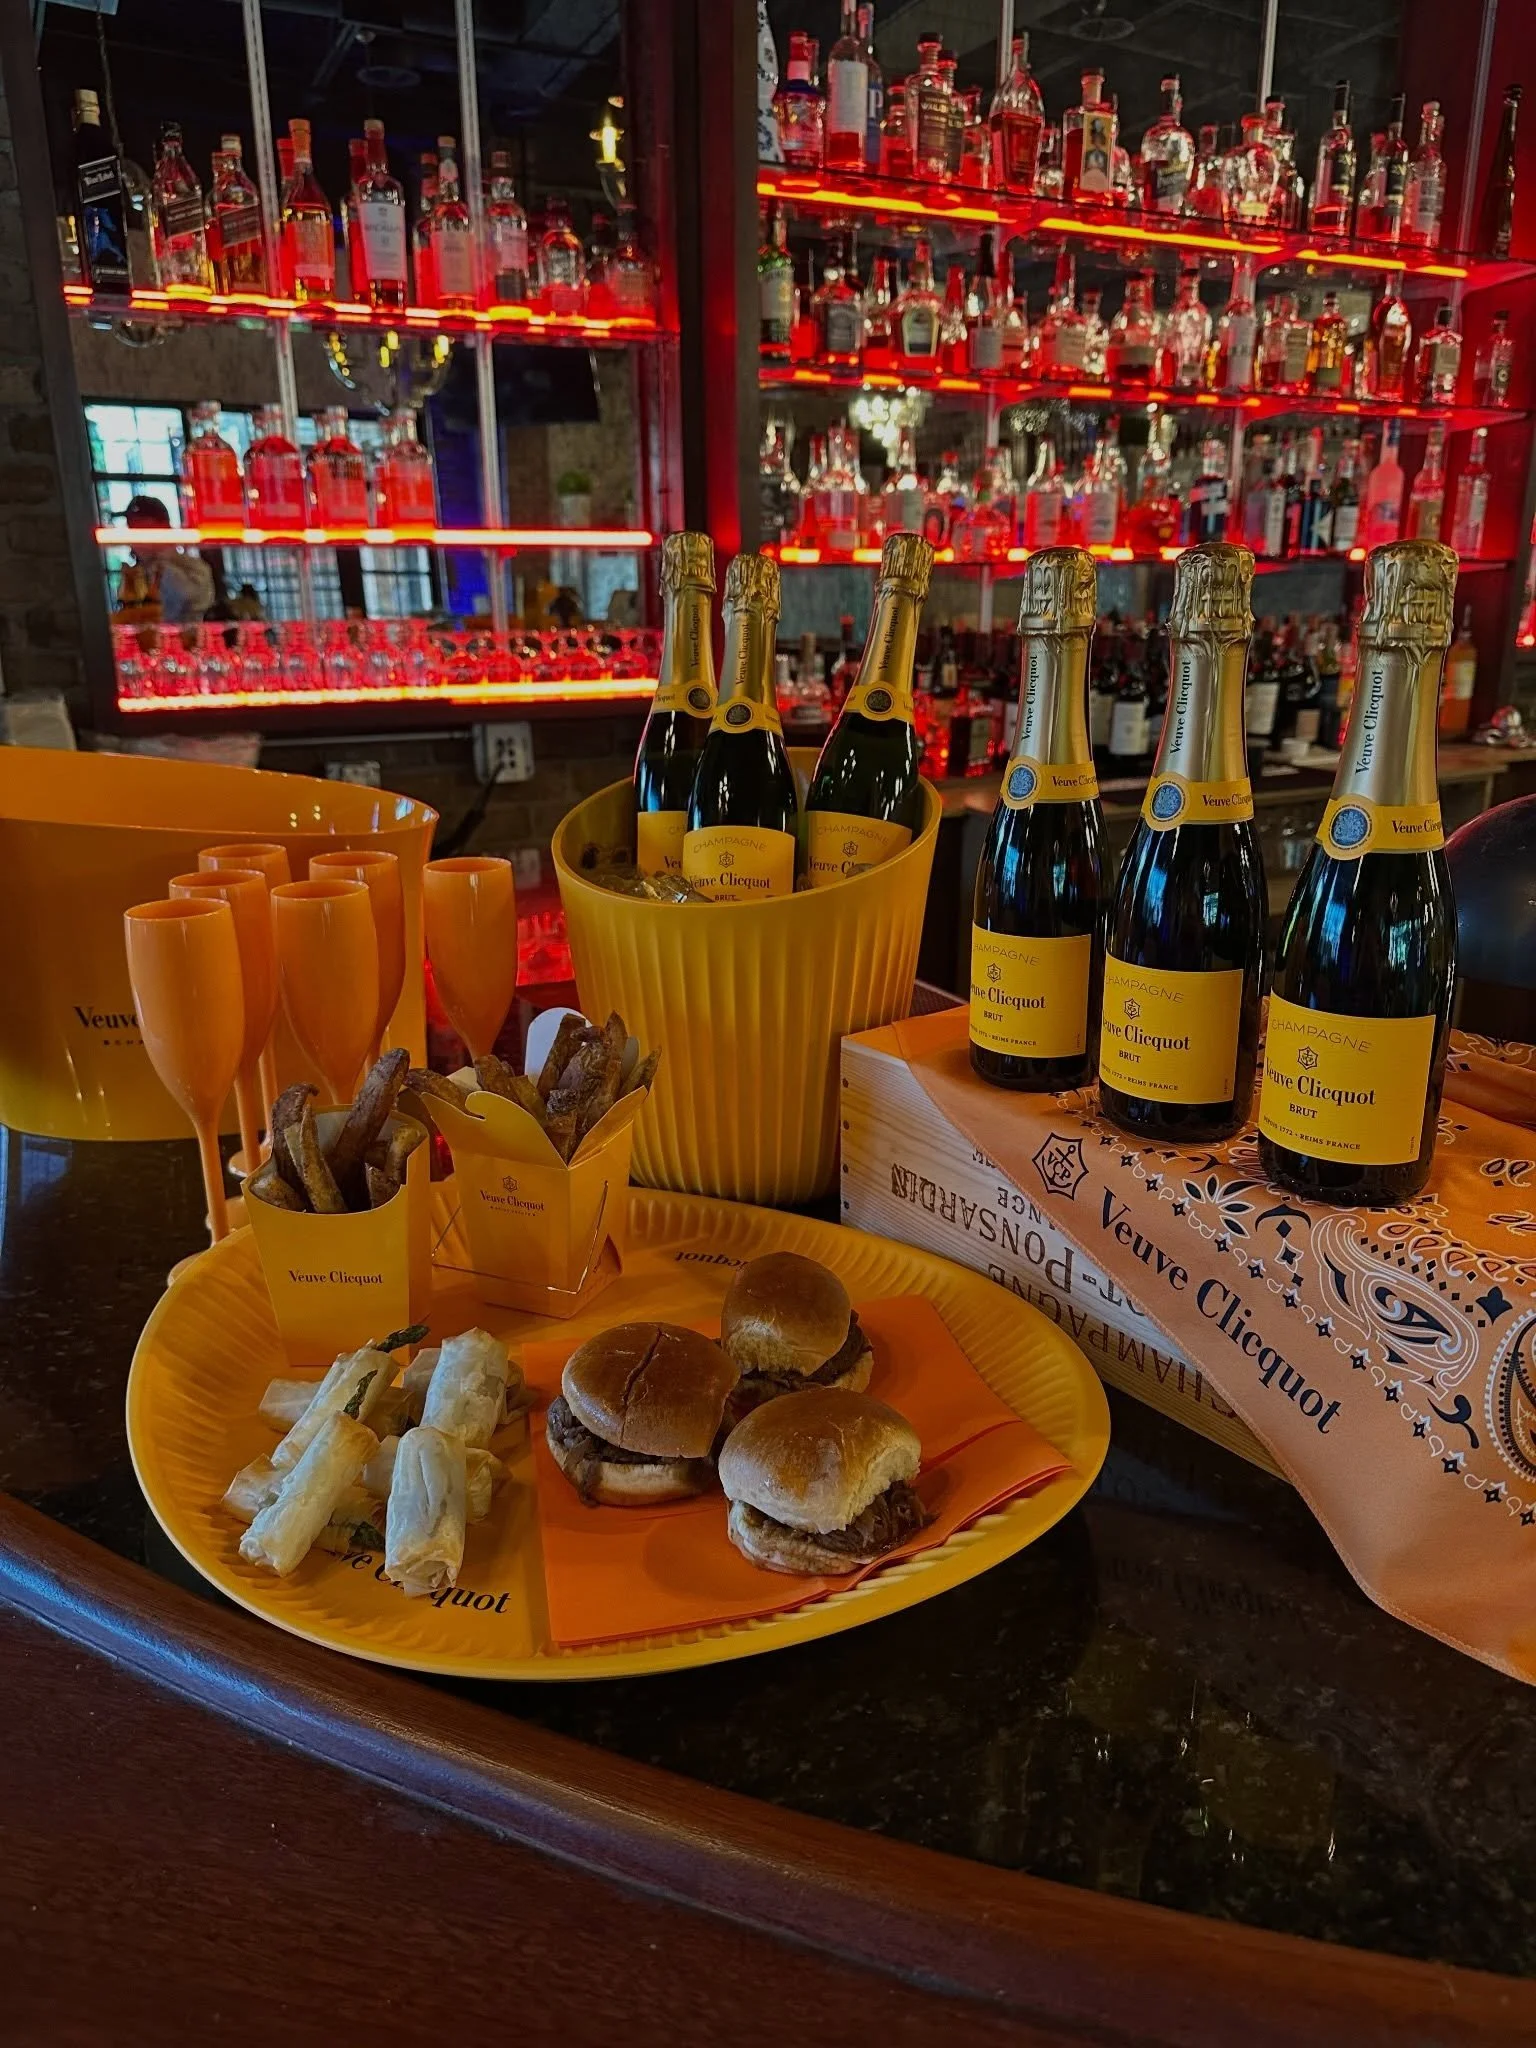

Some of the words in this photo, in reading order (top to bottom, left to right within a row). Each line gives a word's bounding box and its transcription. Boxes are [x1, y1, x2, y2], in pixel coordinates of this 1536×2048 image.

[883, 606, 899, 644] Clicquot
[739, 624, 751, 661] Clicquot
[879, 644, 893, 671] Veuve
[735, 661, 749, 685] Veuve
[1026, 655, 1040, 705] Clicquot
[1175, 660, 1193, 718] Clicquot
[1363, 669, 1384, 731] Clicquot
[1021, 706, 1034, 741] Veuve
[1169, 718, 1185, 754] Veuve
[1355, 733, 1374, 776] Veuve
[1052, 775, 1078, 787] Veuve
[1202, 794, 1231, 807] Veuve
[1391, 819, 1423, 834] Veuve
[693, 835, 769, 854] CHAMPAGNE
[720, 871, 770, 890] Clicquot
[714, 893, 736, 902] BRUT
[988, 986, 1047, 1010] Clicquot
[983, 1009, 1004, 1022] BRUT
[1124, 1024, 1191, 1052] Clicquot
[1271, 1019, 1373, 1054] CHAMPAGNE
[1118, 1049, 1142, 1064] BRUT
[1127, 1076, 1147, 1087] REIMS
[1149, 1081, 1179, 1091] FRANCE
[1297, 1075, 1377, 1107] Clicquot
[1289, 1102, 1318, 1119] BRUT
[1279, 1124, 1294, 1137] 1772
[1299, 1133, 1324, 1146] REIMS
[1326, 1139, 1361, 1151] FRANCE
[480, 1189, 505, 1205] Veuve
[507, 1195, 545, 1212] Clicquot
[288, 1269, 327, 1283] Veuve
[329, 1269, 384, 1286] Clicquot
[1100, 1185, 1189, 1291] Veuve
[1196, 1278, 1343, 1435] Clicquot
